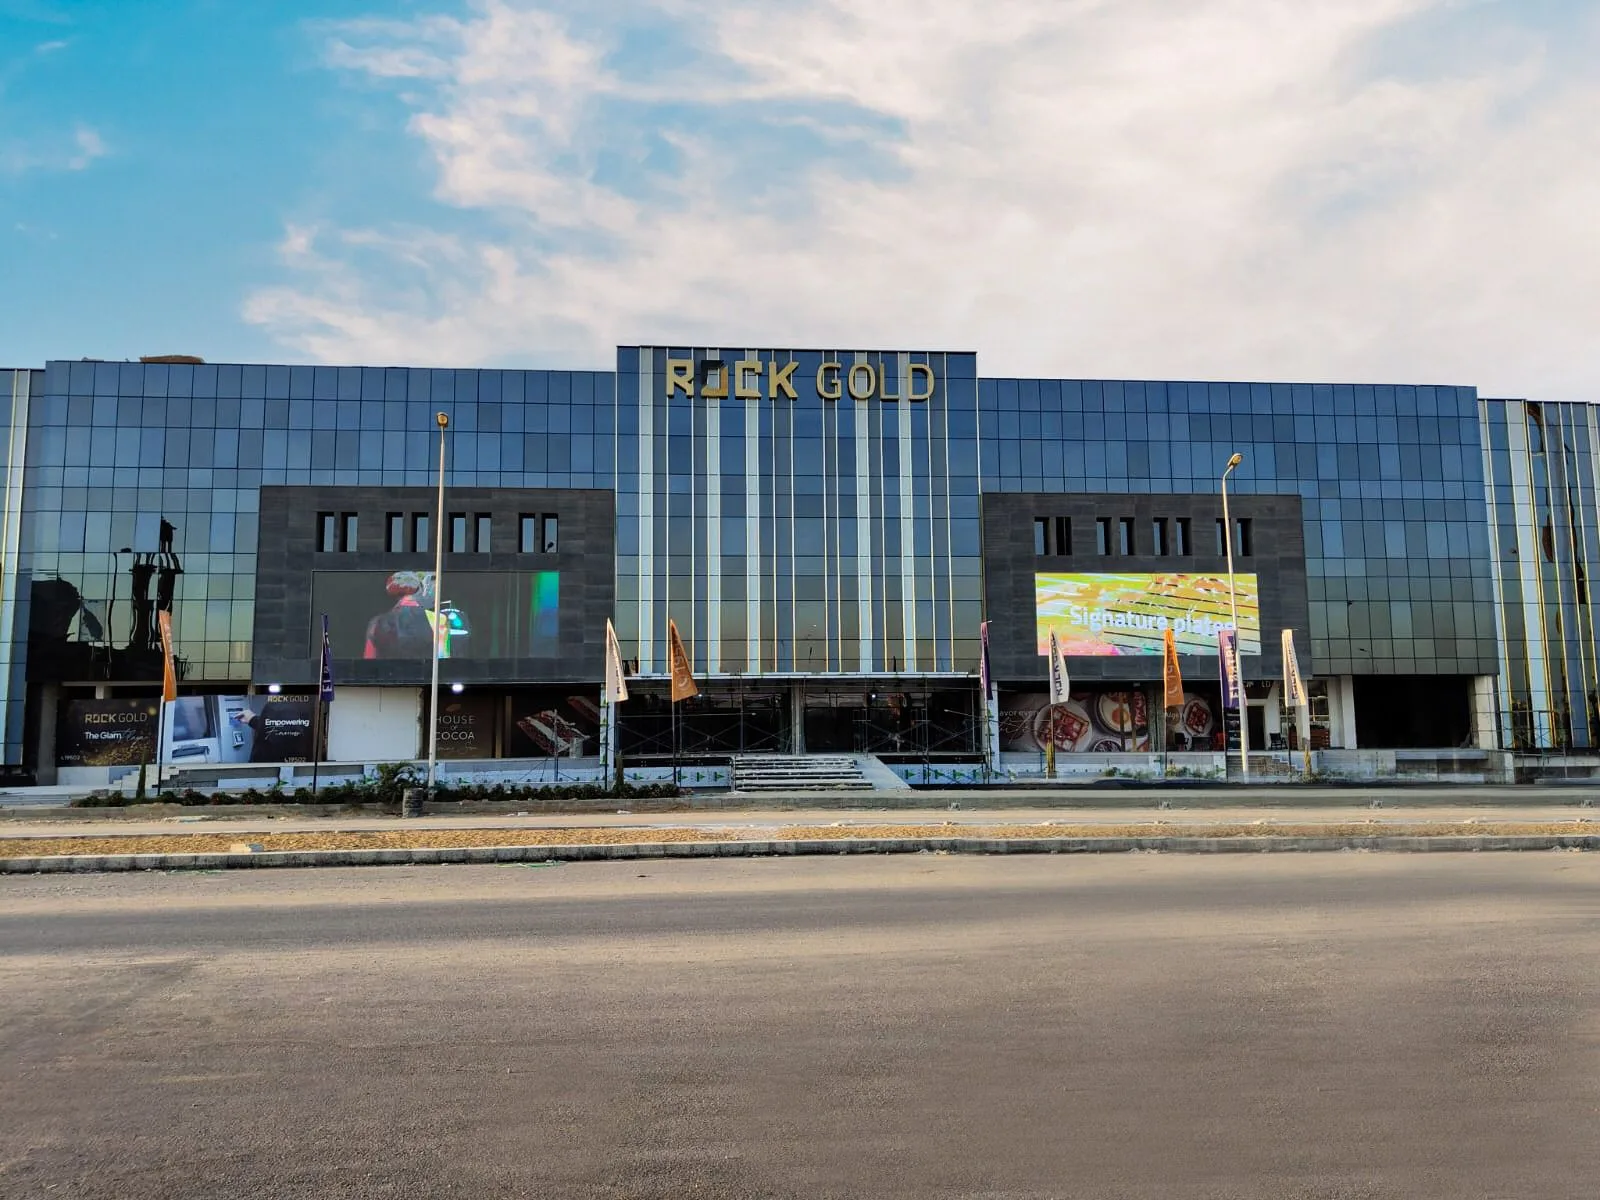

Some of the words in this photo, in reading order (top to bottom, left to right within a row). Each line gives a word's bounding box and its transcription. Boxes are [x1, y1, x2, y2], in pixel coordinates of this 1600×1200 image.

[665, 358, 799, 400] ROCK
[815, 361, 935, 401] GOLD
[1069, 606, 1168, 632] Signature
[267, 695, 288, 703] ROCK
[289, 695, 309, 703] GOLD
[84, 713, 116, 724] ROCK
[118, 712, 148, 723] GOLD
[264, 718, 310, 727] Empowering
[435, 715, 477, 725] HOUSE
[84, 731, 100, 740] The
[100, 731, 122, 741] Glam
